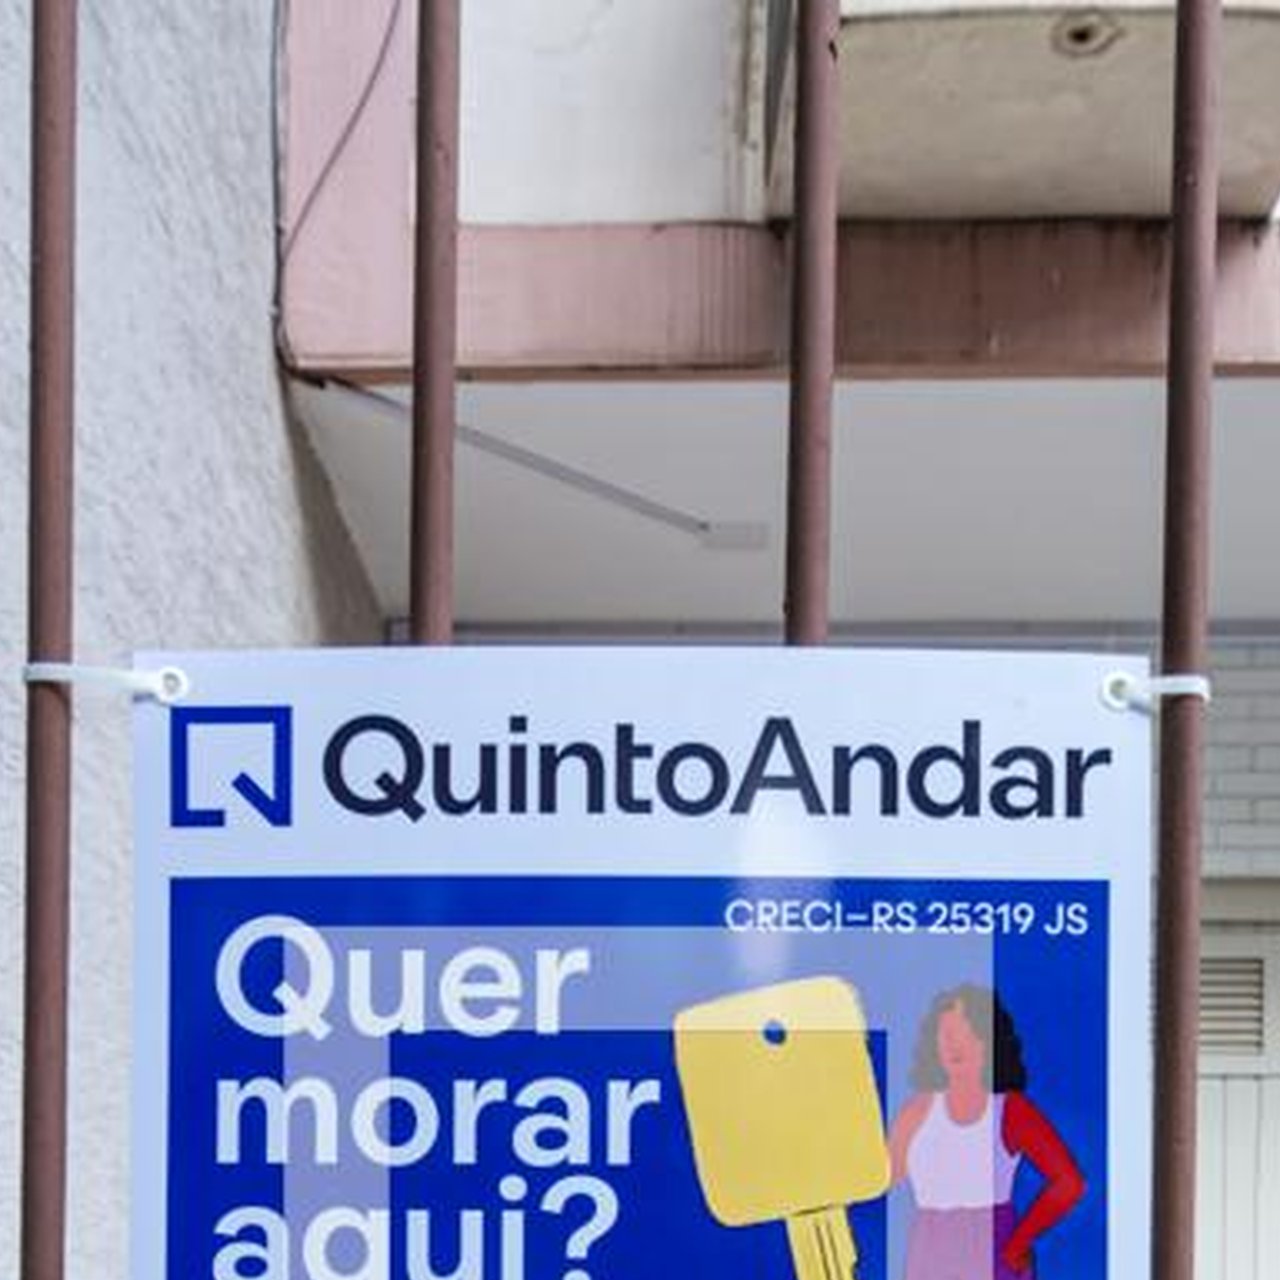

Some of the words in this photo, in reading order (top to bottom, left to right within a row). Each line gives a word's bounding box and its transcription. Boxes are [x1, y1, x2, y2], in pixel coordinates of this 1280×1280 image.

[322, 713, 1112, 823] QuintoAndar
[929, 901, 1036, 936] 25319
[1045, 903, 1089, 936] JS
[215, 915, 590, 1042] Quer
[215, 1074, 660, 1167] morar
